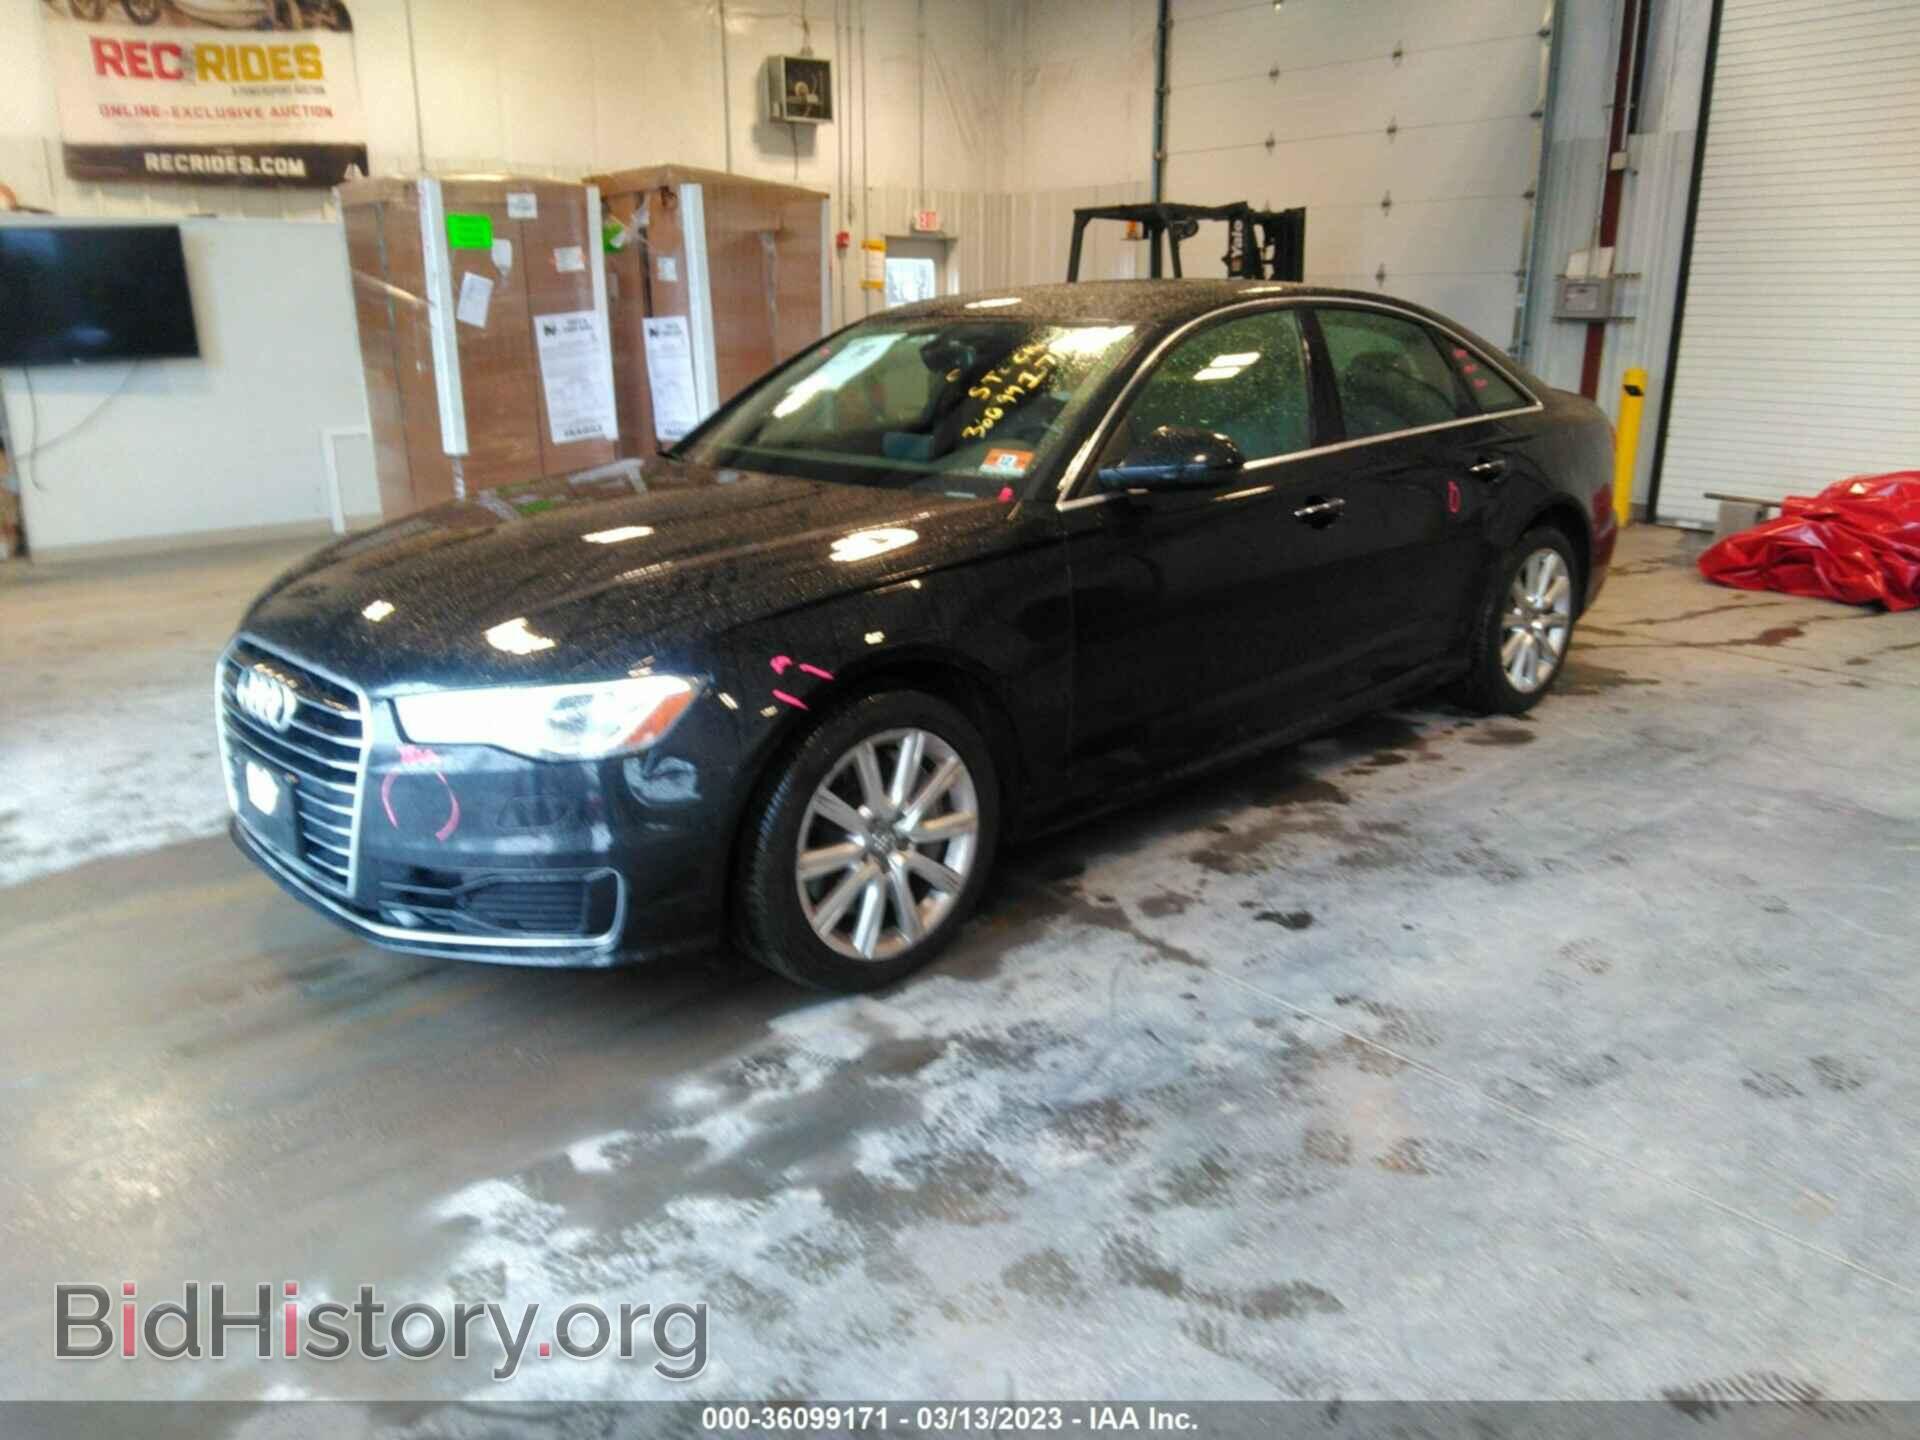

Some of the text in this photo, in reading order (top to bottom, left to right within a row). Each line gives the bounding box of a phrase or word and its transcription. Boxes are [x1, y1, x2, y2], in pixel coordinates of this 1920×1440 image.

[89, 36, 324, 81] REC RIDES
[99, 104, 335, 119] ONLINE-EXCLUSIVE AUCTION
[144, 152, 307, 177] RECRIDES.COM
